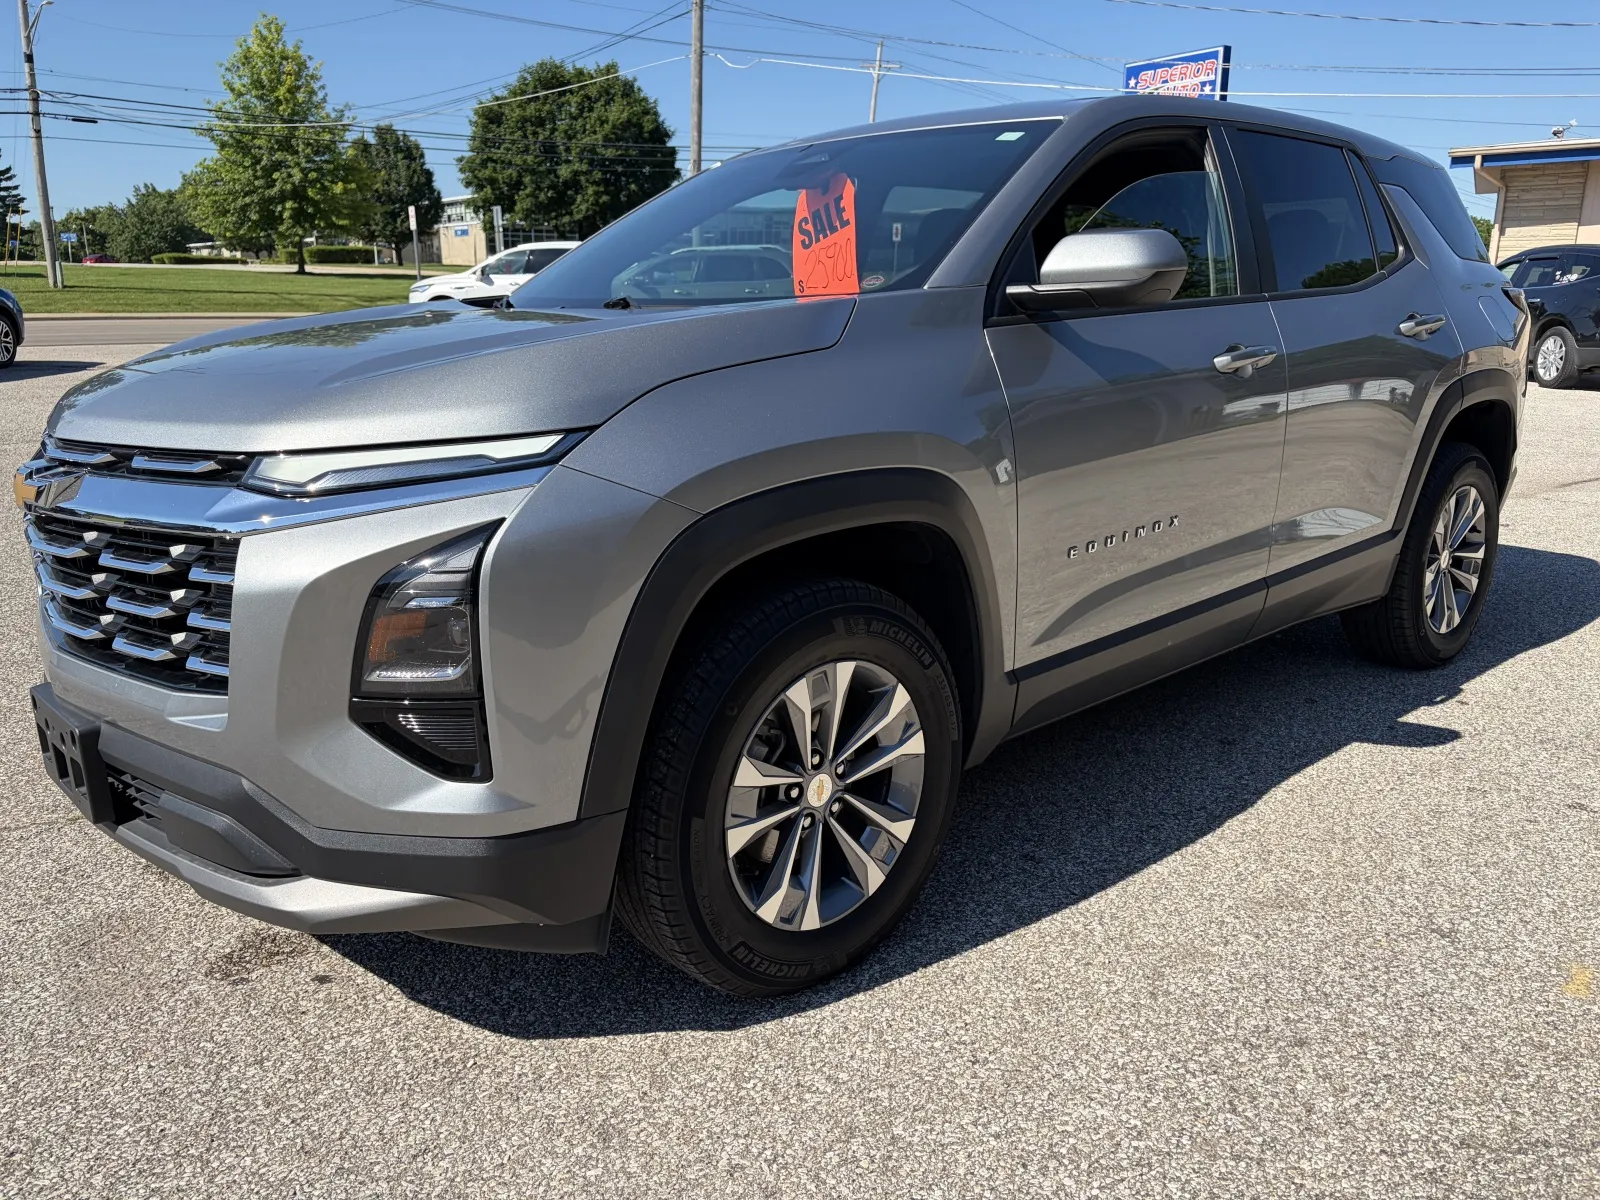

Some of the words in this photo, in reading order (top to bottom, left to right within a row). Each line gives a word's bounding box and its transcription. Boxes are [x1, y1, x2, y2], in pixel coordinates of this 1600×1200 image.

[1137, 60, 1217, 88] SUPERIOR
[798, 194, 850, 250] SALE
[1067, 515, 1179, 559] EQUINOX
[870, 620, 933, 666] MICHELIN
[700, 894, 728, 941] PRIMACY
[732, 945, 812, 977] MICHELIN
